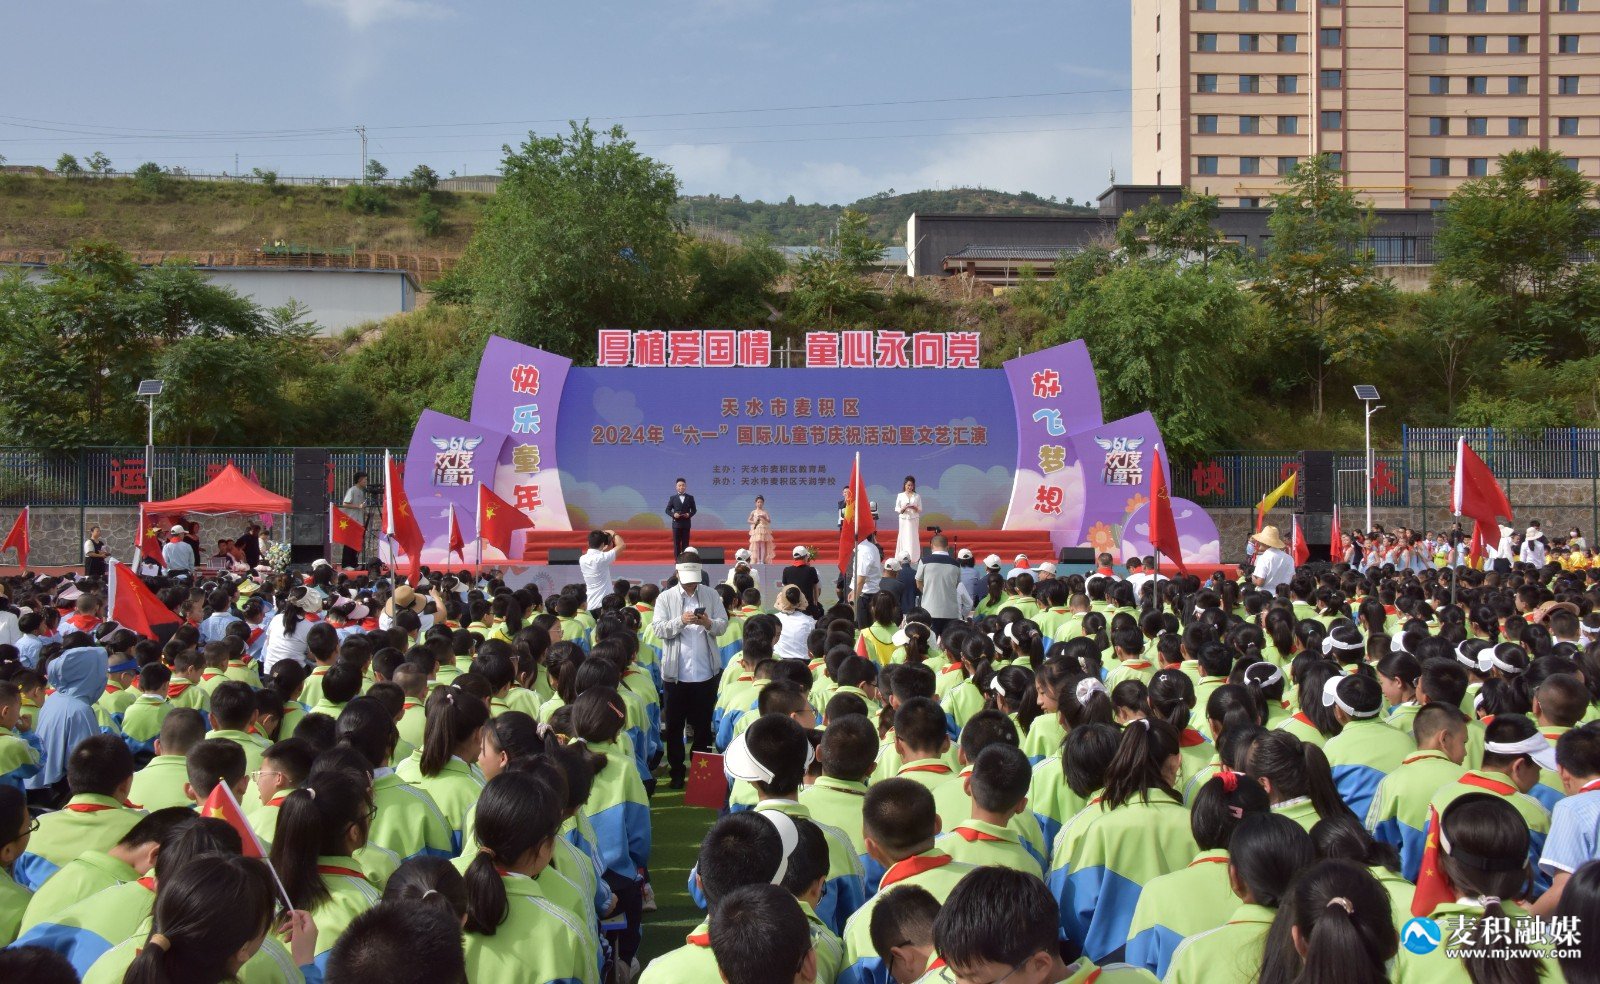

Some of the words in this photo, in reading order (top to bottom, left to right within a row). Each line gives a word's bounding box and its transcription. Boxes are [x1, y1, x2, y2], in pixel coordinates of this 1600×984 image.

[598, 329, 772, 368] 厚植爱国情
[805, 330, 981, 369] 童心永向党
[721, 397, 860, 417] 天水市麦积区
[511, 363, 543, 513] 快乐童年
[1031, 368, 1067, 517] 放飞梦想
[111, 459, 147, 495] 运
[1192, 461, 1227, 497] 快
